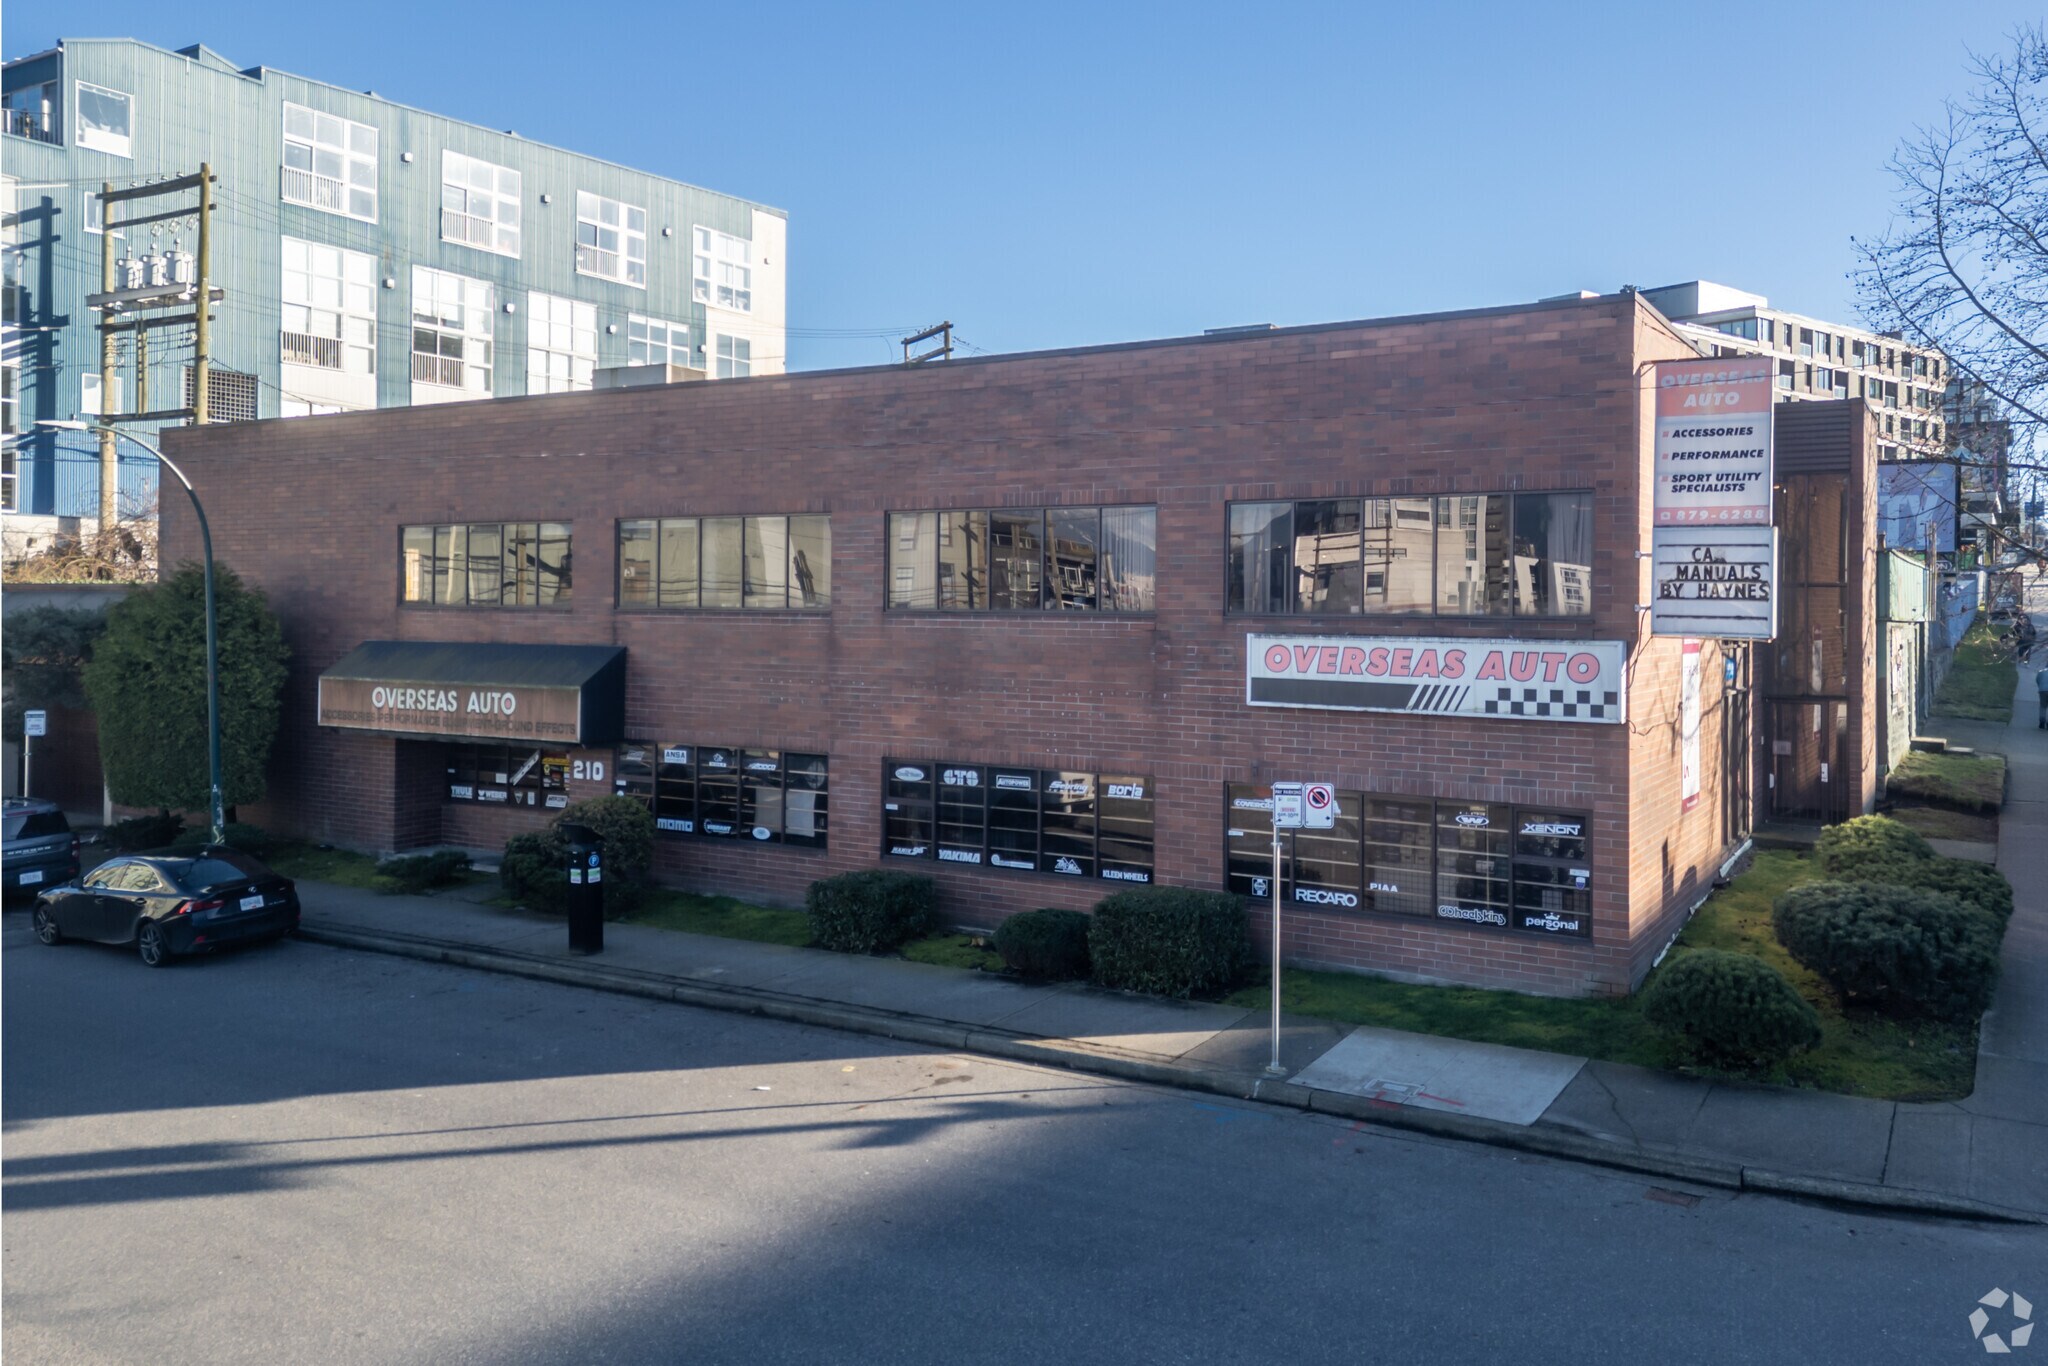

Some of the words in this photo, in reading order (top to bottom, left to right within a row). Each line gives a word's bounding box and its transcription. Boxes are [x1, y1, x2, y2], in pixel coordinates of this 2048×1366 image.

[1660, 369, 1766, 388] OVERSEAS
[1684, 391, 1740, 407] AUTO
[1672, 427, 1753, 438] ACCESSORIES
[1671, 449, 1764, 460] PERFORMANCE
[1671, 473, 1711, 483] SPORT
[1715, 472, 1762, 482] UTILITY
[1671, 483, 1746, 493] SPECIALISTS
[1676, 509, 1765, 521] 879-6288
[1676, 565, 1761, 581] MANUALS
[1660, 582, 1684, 598] BY
[1698, 582, 1769, 599] HAYNES
[1264, 644, 1466, 679] OVERSEAS
[1475, 650, 1600, 684] AUTO
[372, 686, 458, 712] OVERSEAS
[467, 691, 516, 715] AUTO
[573, 760, 604, 781] 210
[1522, 823, 1580, 835] XENON
[938, 849, 980, 864] YAKIMA
[1102, 869, 1123, 880] KLEEN
[1123, 871, 1149, 882] WHEELS
[1369, 882, 1398, 892] PIAA
[1295, 888, 1358, 907] RECARO
